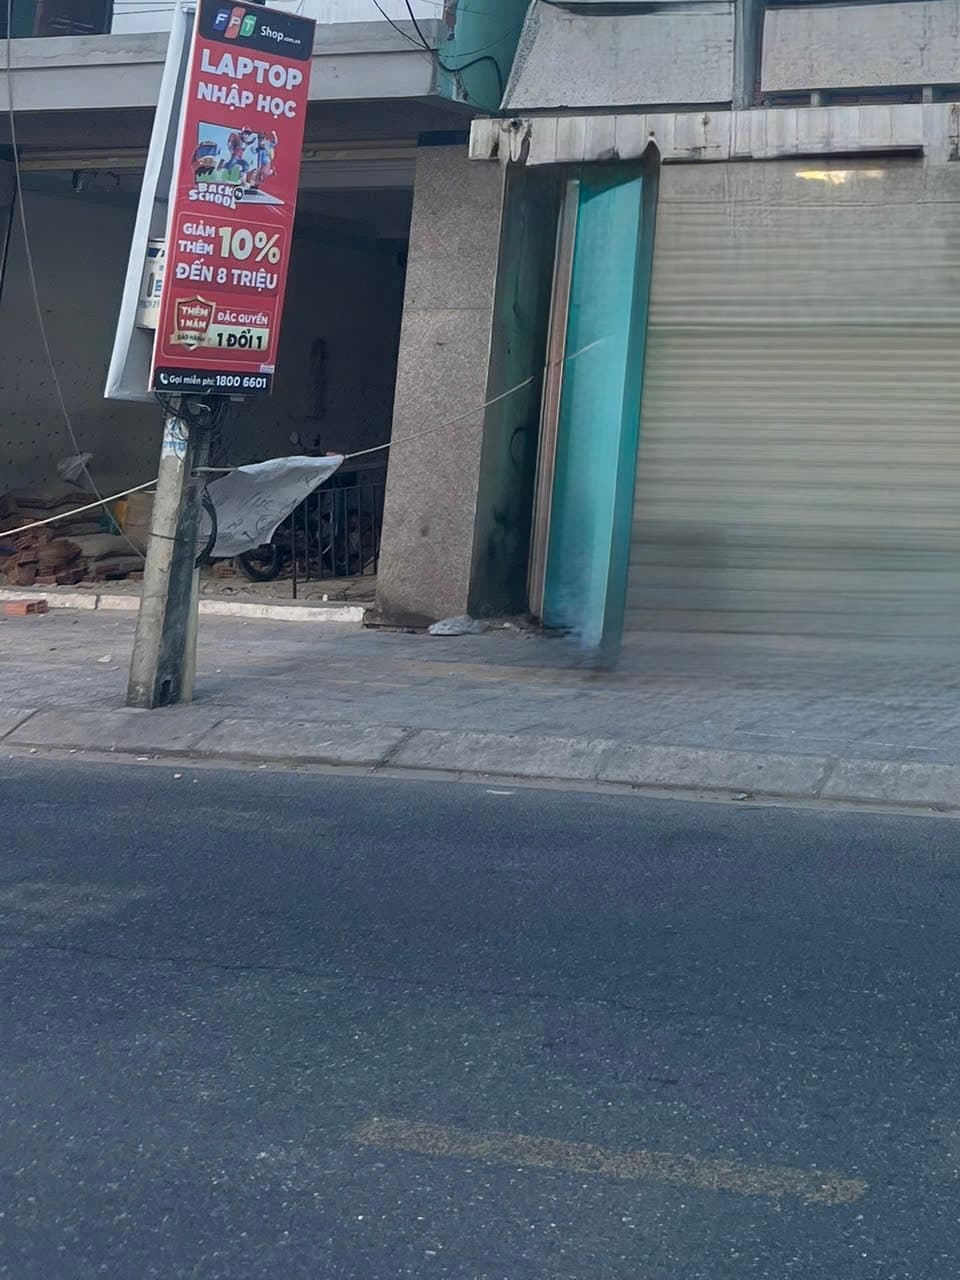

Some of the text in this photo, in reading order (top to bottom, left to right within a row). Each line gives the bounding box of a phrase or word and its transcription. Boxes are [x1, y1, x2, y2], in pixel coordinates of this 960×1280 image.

[214, 8, 257, 36] FPT
[201, 48, 303, 91] LAPTOP
[197, 81, 297, 120] NHẬP HỌC
[188, 189, 237, 210] SCHOOL
[197, 182, 234, 196] BACK
[182, 220, 216, 238] GIẢM
[178, 239, 214, 256] THÊM
[218, 226, 281, 264] 10%
[175, 258, 278, 292] ĐẾN 8 TRIỆU
[217, 310, 238, 324] ĐẶC
[216, 328, 263, 350] 1 ĐỔI 1
[216, 375, 241, 387] 1800
[242, 376, 267, 388] 6601
